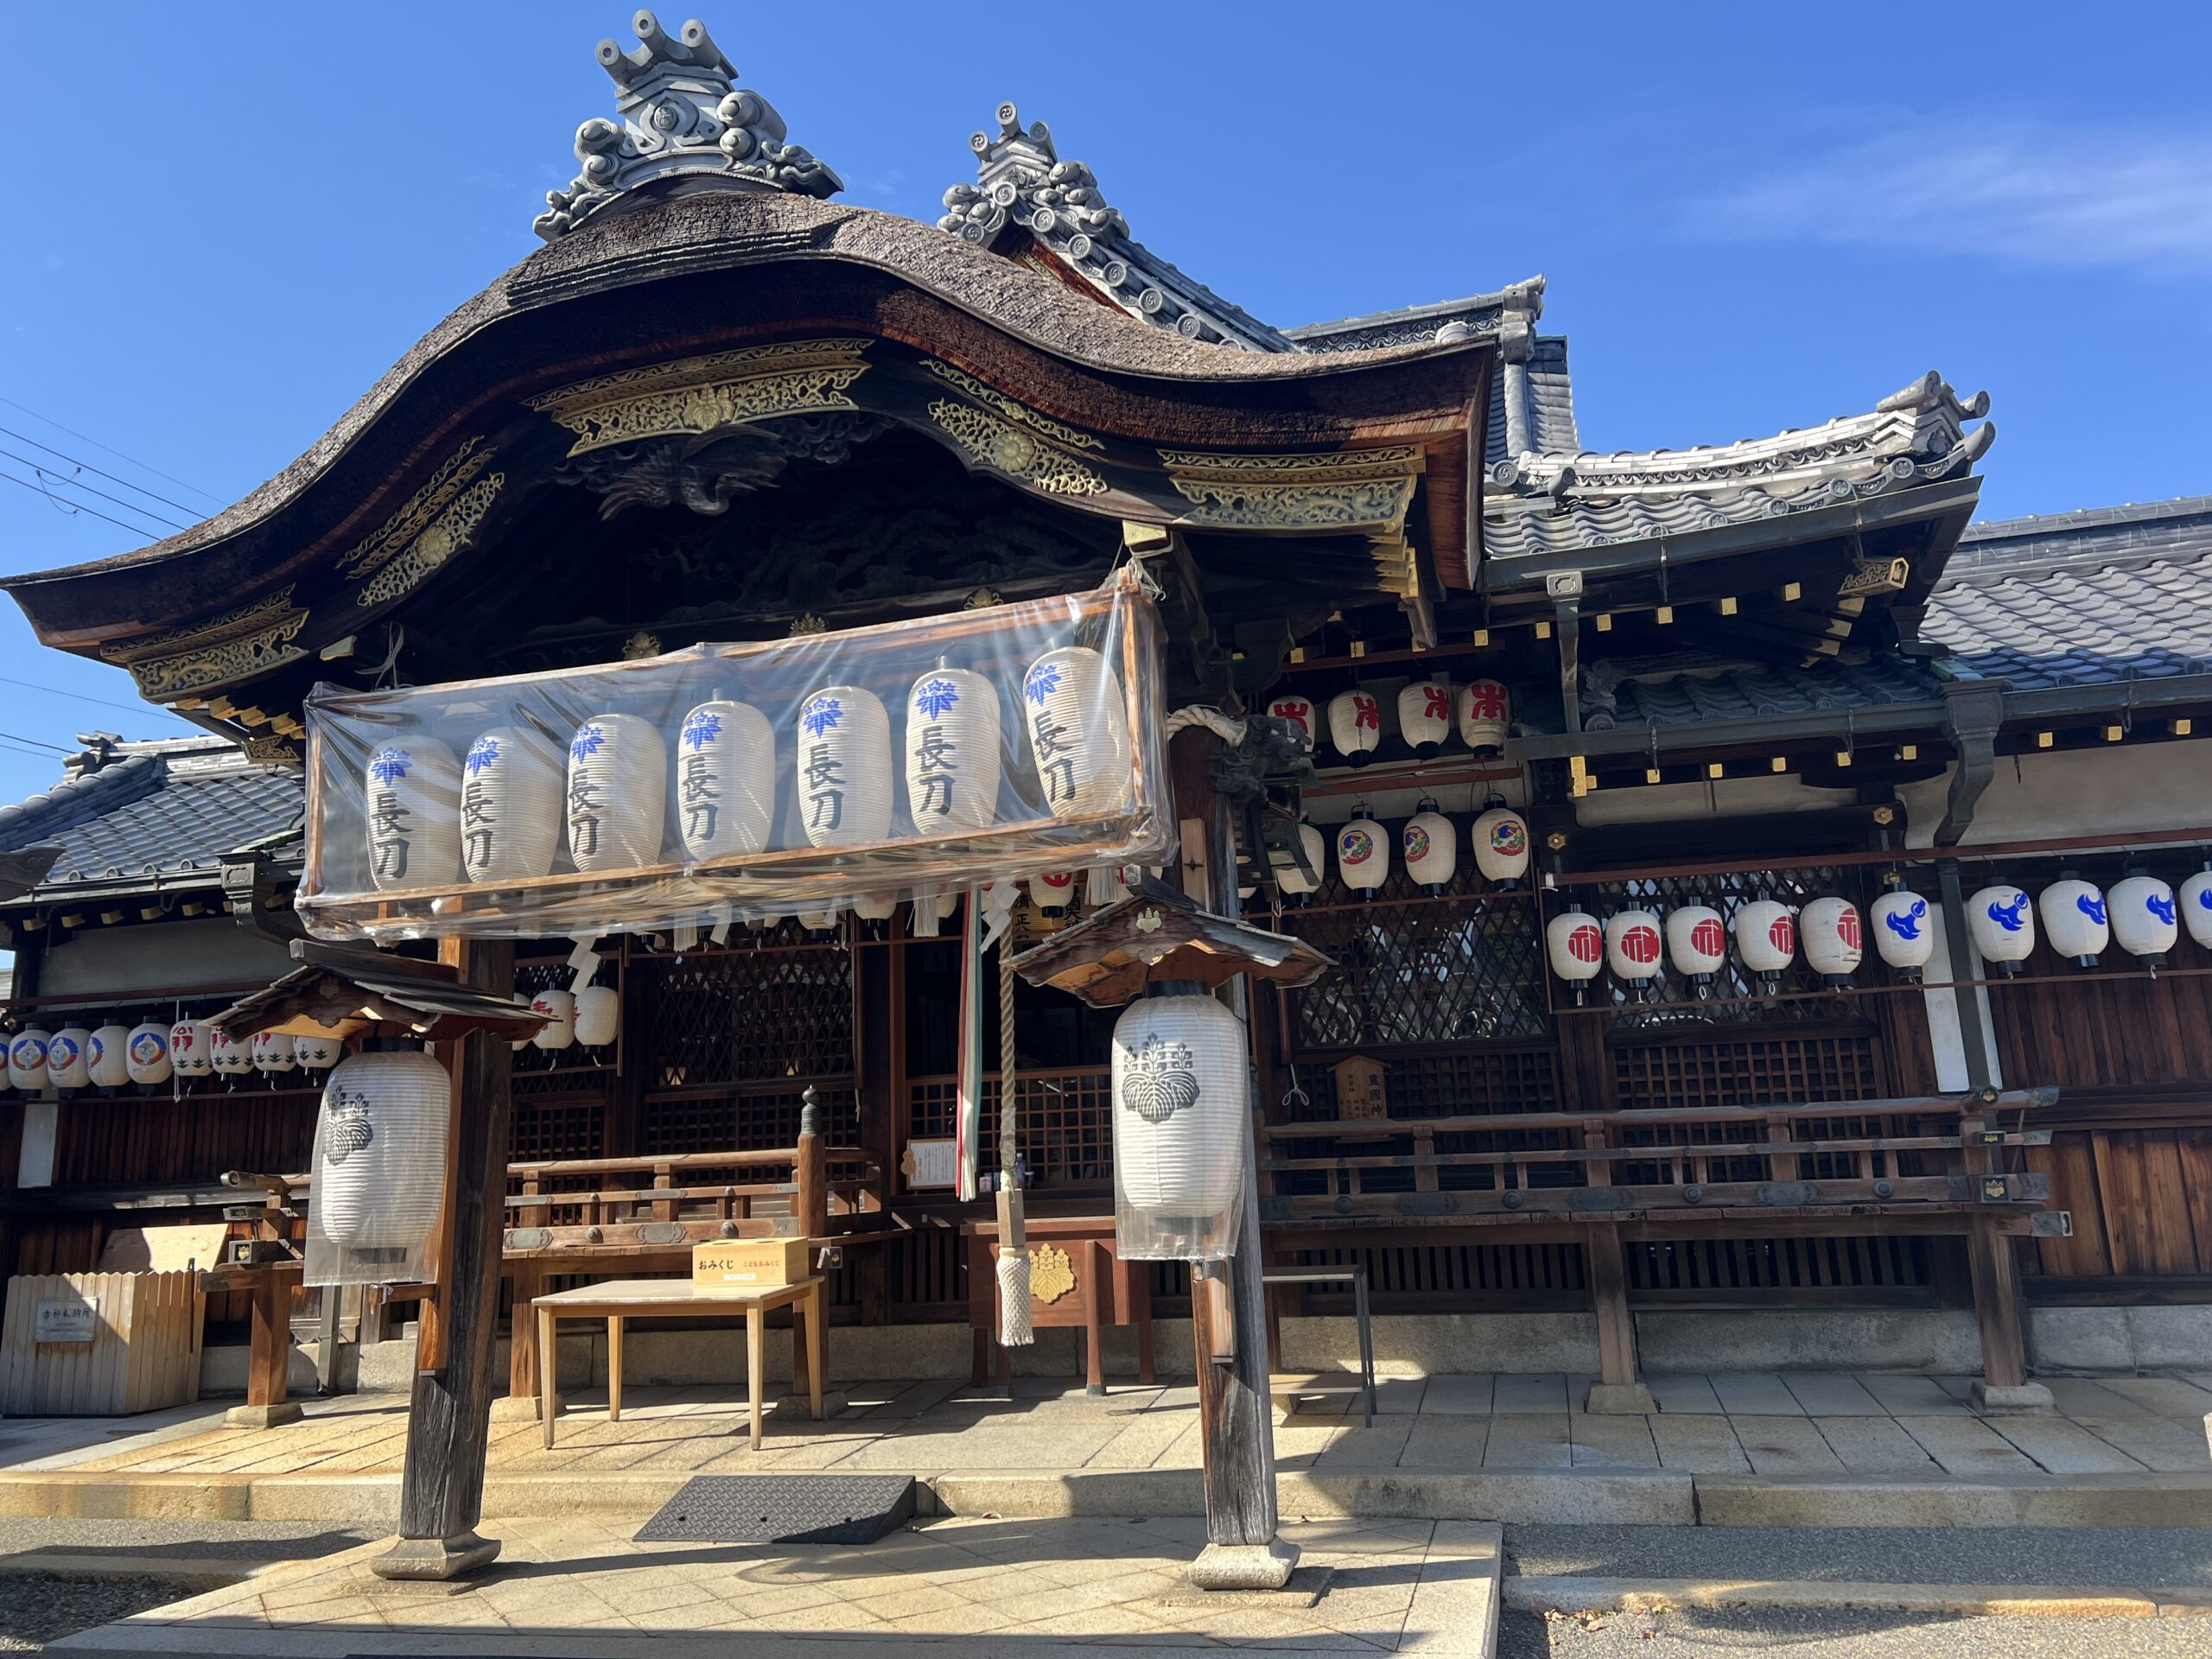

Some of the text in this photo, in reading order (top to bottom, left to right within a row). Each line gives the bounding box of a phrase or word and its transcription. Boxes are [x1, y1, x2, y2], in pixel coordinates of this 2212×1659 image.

[683, 756, 721, 840] 長刀
[804, 743, 846, 830] 長刀
[915, 726, 957, 816] 長刀
[1034, 710, 1077, 803] 長刀
[372, 791, 413, 879] 長刀
[462, 782, 495, 868] 長刀
[569, 768, 603, 855] 長刀
[698, 1259, 734, 1270] おみくじ
